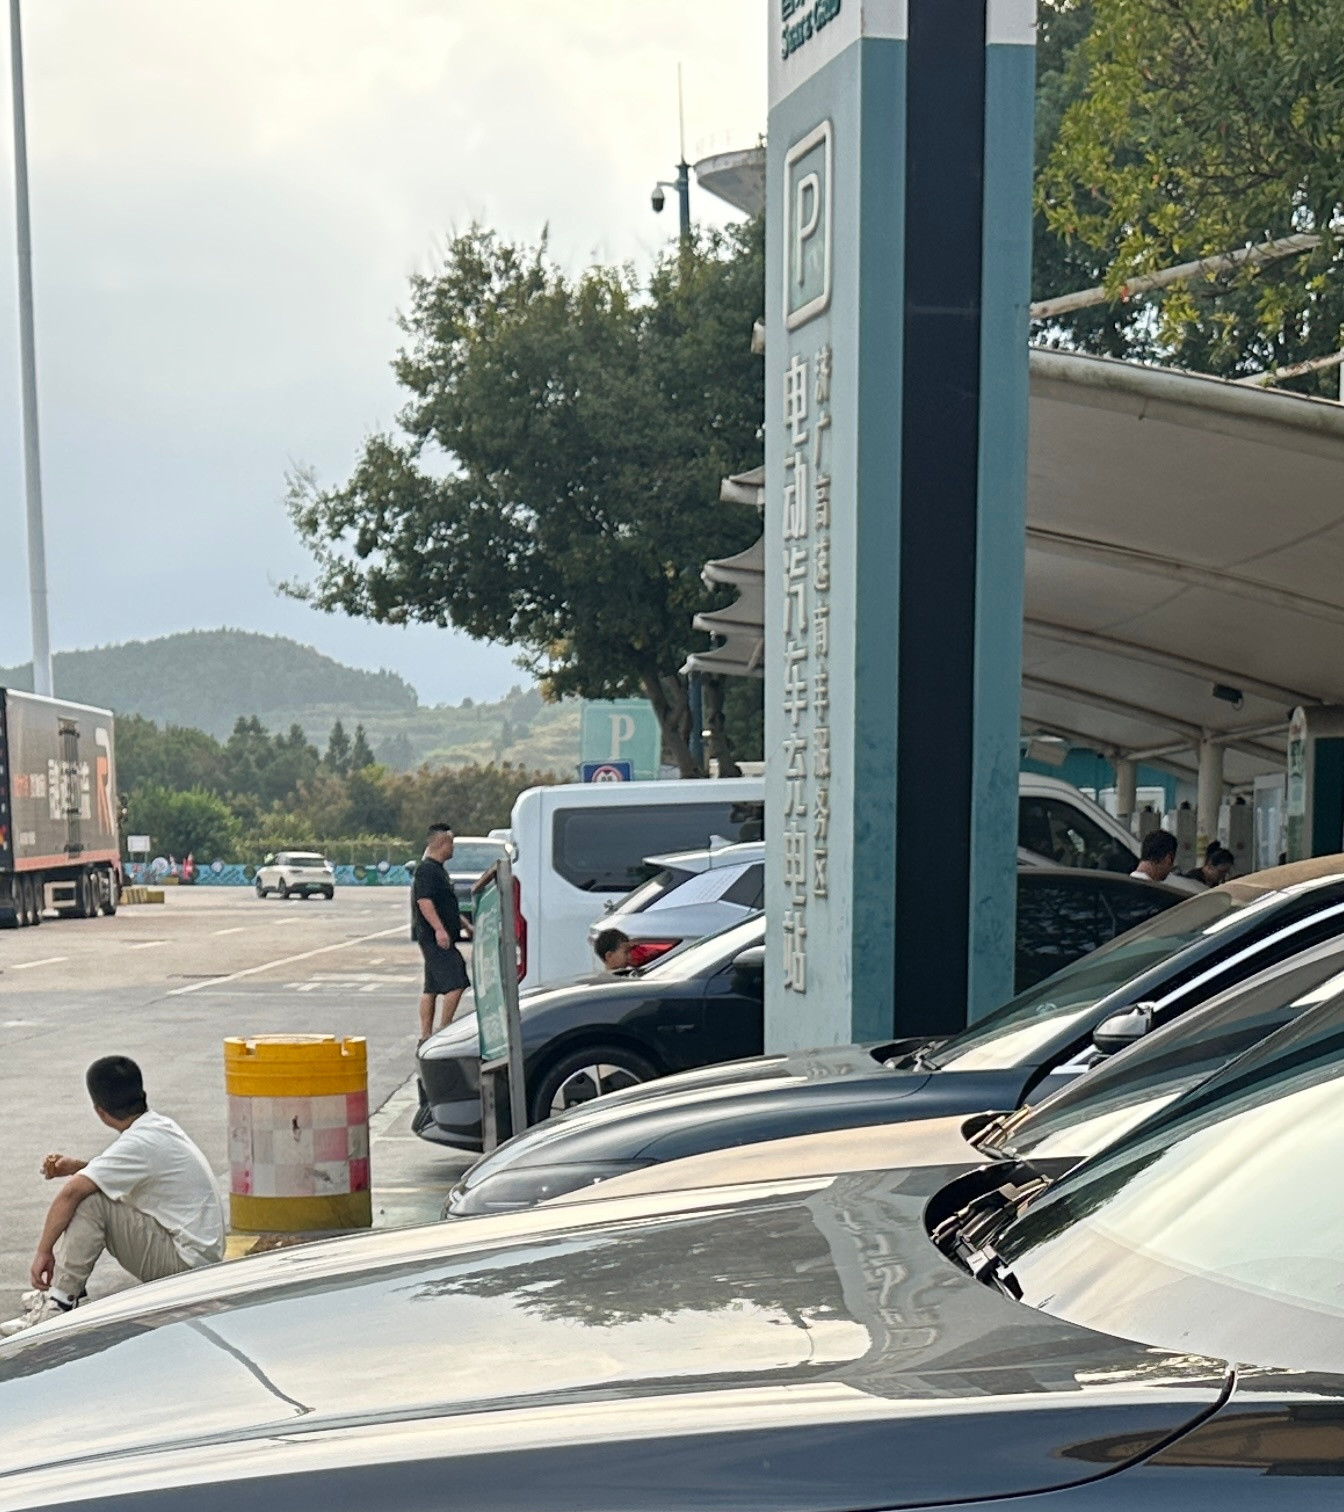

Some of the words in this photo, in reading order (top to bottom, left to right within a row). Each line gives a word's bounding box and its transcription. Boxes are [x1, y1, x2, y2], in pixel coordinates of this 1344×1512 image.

[795, 172, 819, 289] P
[782, 355, 808, 994] 电动汽车充电站
[608, 713, 636, 761] P
